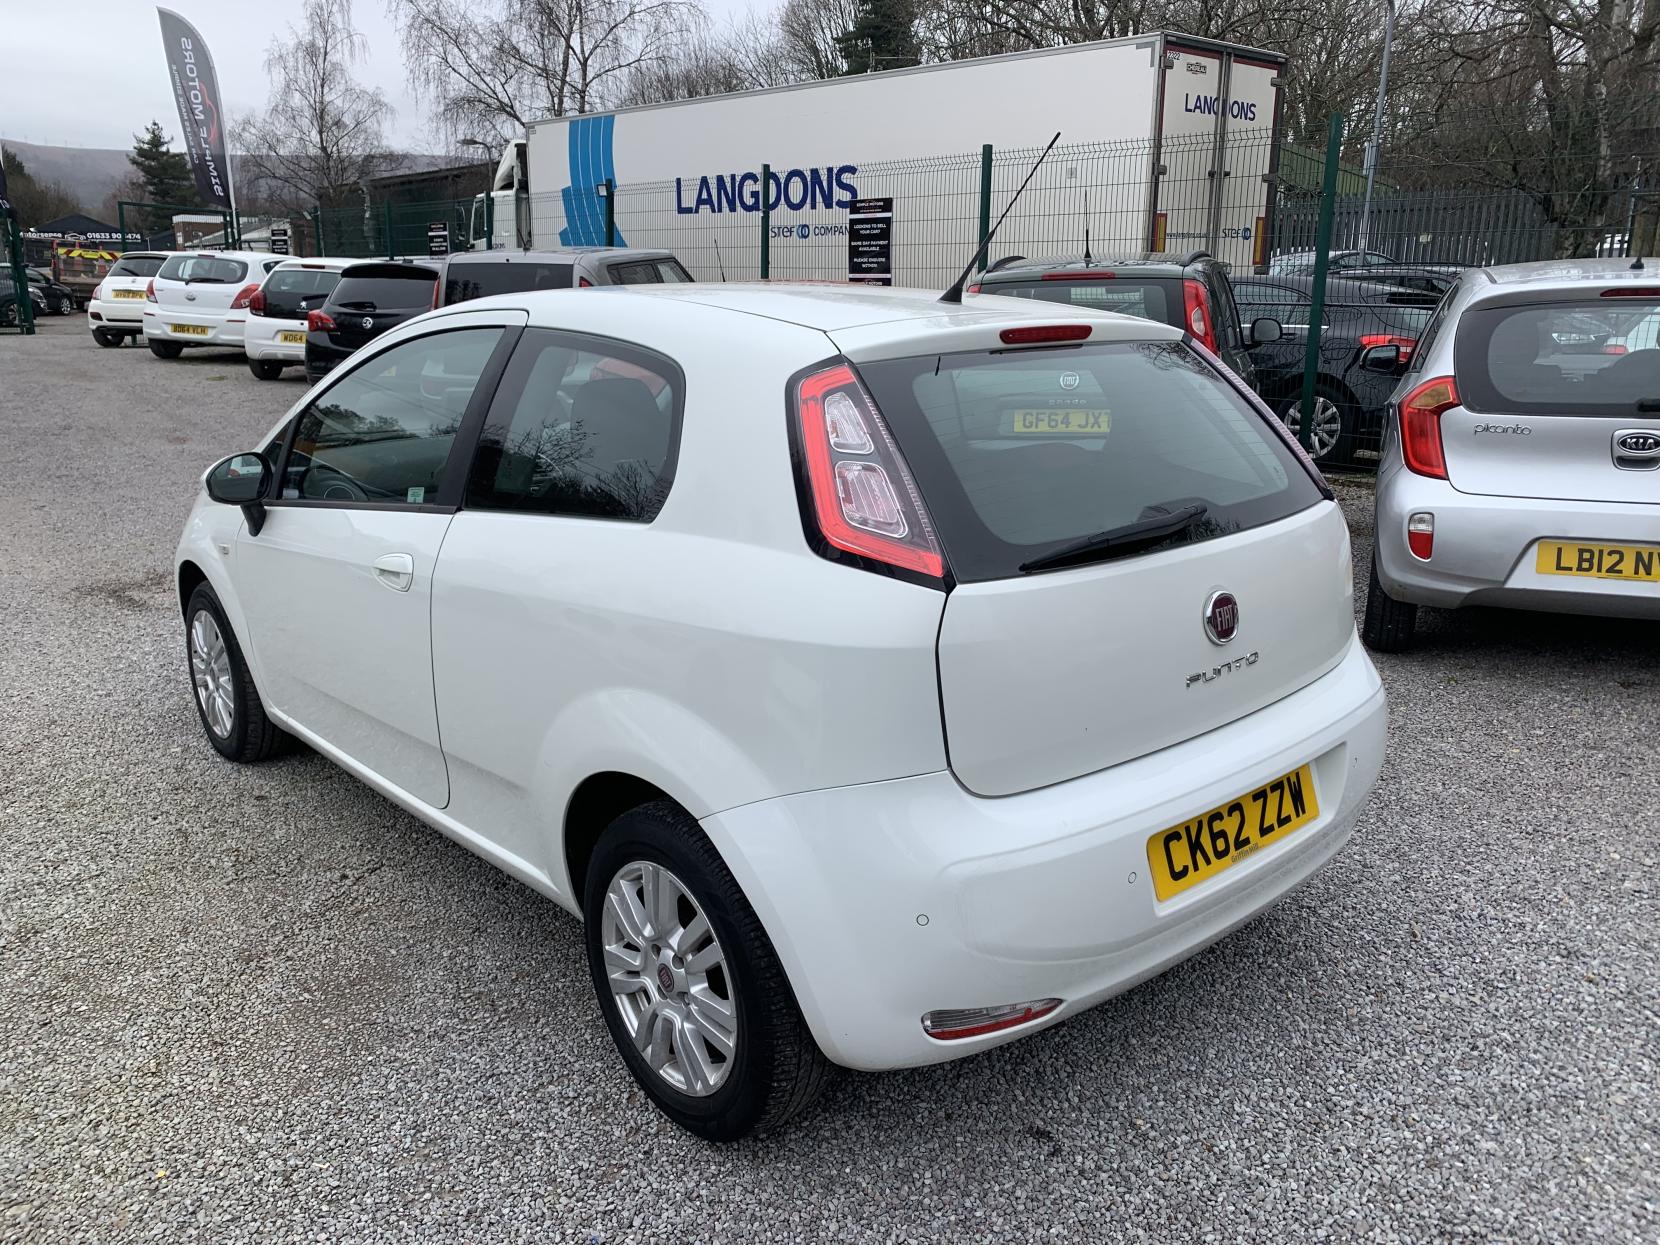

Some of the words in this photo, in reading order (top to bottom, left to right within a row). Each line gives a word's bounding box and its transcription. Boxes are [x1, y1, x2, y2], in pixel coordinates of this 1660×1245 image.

[1184, 93, 1257, 121] LANGONS
[675, 164, 858, 215] LANGDONS
[813, 225, 850, 238] COMPAN
[1022, 411, 1071, 429] GF64
[1474, 422, 1532, 436] picanto
[1626, 438, 1656, 449] KIA
[1555, 547, 1625, 575] LB12
[1633, 551, 1660, 577] N
[1215, 604, 1235, 632] FIAT
[1186, 651, 1259, 689] PUNTO
[1163, 801, 1251, 882] CK62
[1251, 771, 1307, 838] ZZW
